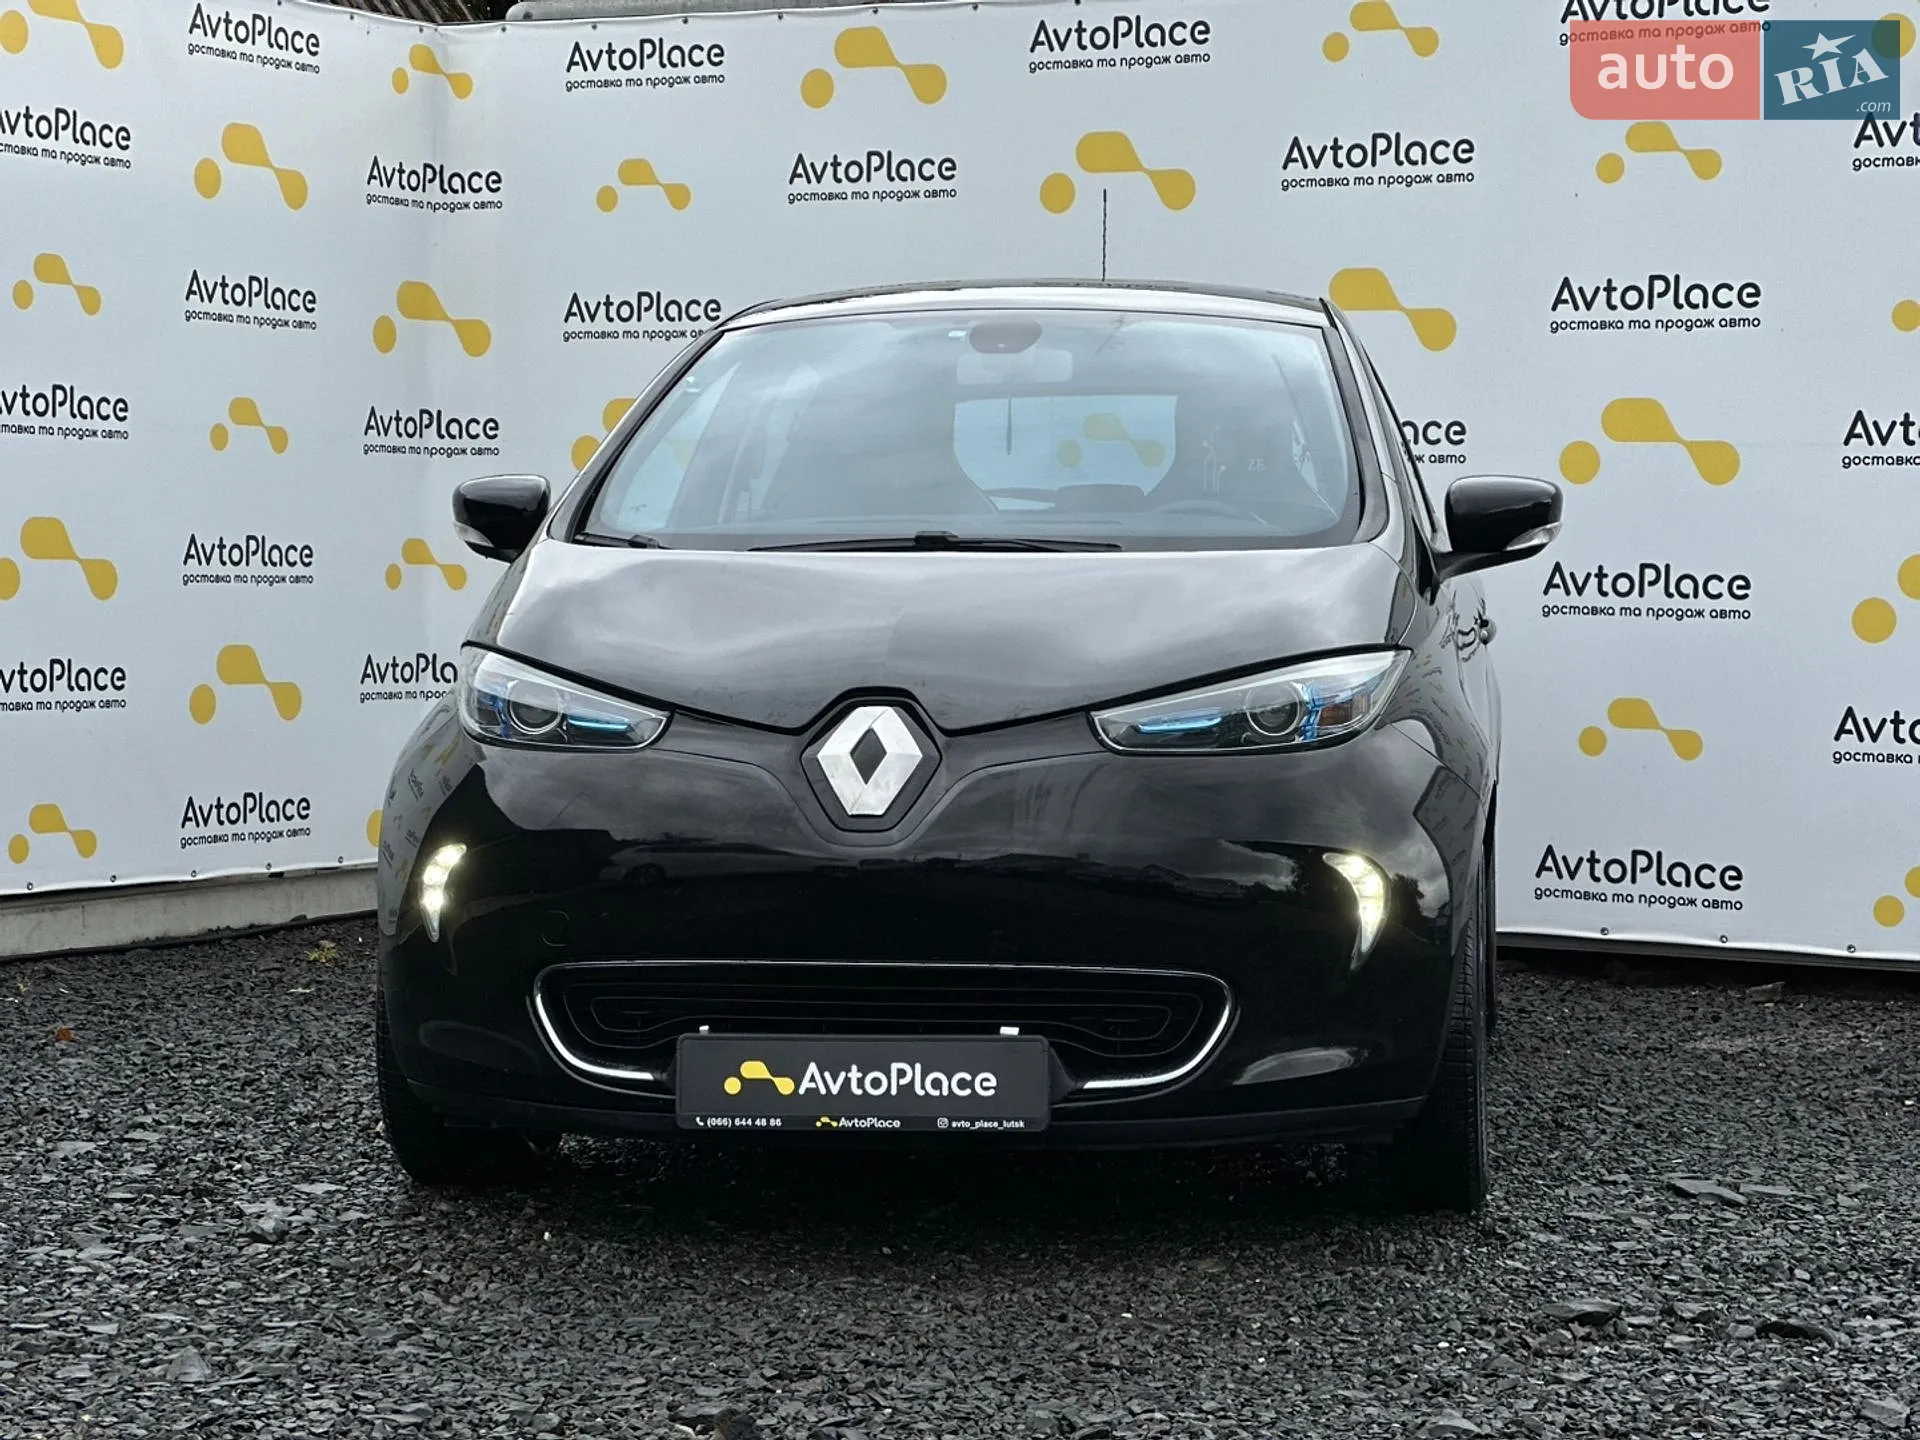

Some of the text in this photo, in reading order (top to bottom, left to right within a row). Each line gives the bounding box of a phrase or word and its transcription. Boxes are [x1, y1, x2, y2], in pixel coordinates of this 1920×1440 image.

[188, 2, 320, 57] AvtoPlace
[1030, 15, 1210, 53] AvtoPlace
[566, 37, 725, 73] AvtoPlace
[789, 150, 957, 185] AvtoPlace
[1282, 132, 1474, 170] AvtoPlace
[367, 155, 502, 194] AvtoPlace
[186, 269, 316, 313] AvtoPlace
[564, 291, 722, 323] AvtoPlace
[1551, 274, 1761, 312] AvtoPlace
[0, 384, 128, 422] vtoPlace
[364, 406, 499, 440] AvtoPlace
[183, 534, 313, 568] AvtoPlace
[1543, 561, 1751, 600] AvtoPlace
[0, 658, 126, 693] vtoPlace
[360, 653, 458, 684] AvtoPla
[181, 792, 311, 829] AvtoPlace
[1535, 844, 1743, 891] AvtoPlace
[798, 1061, 997, 1097] AvtoPlace
[839, 1117, 900, 1128] AvtoPlace
